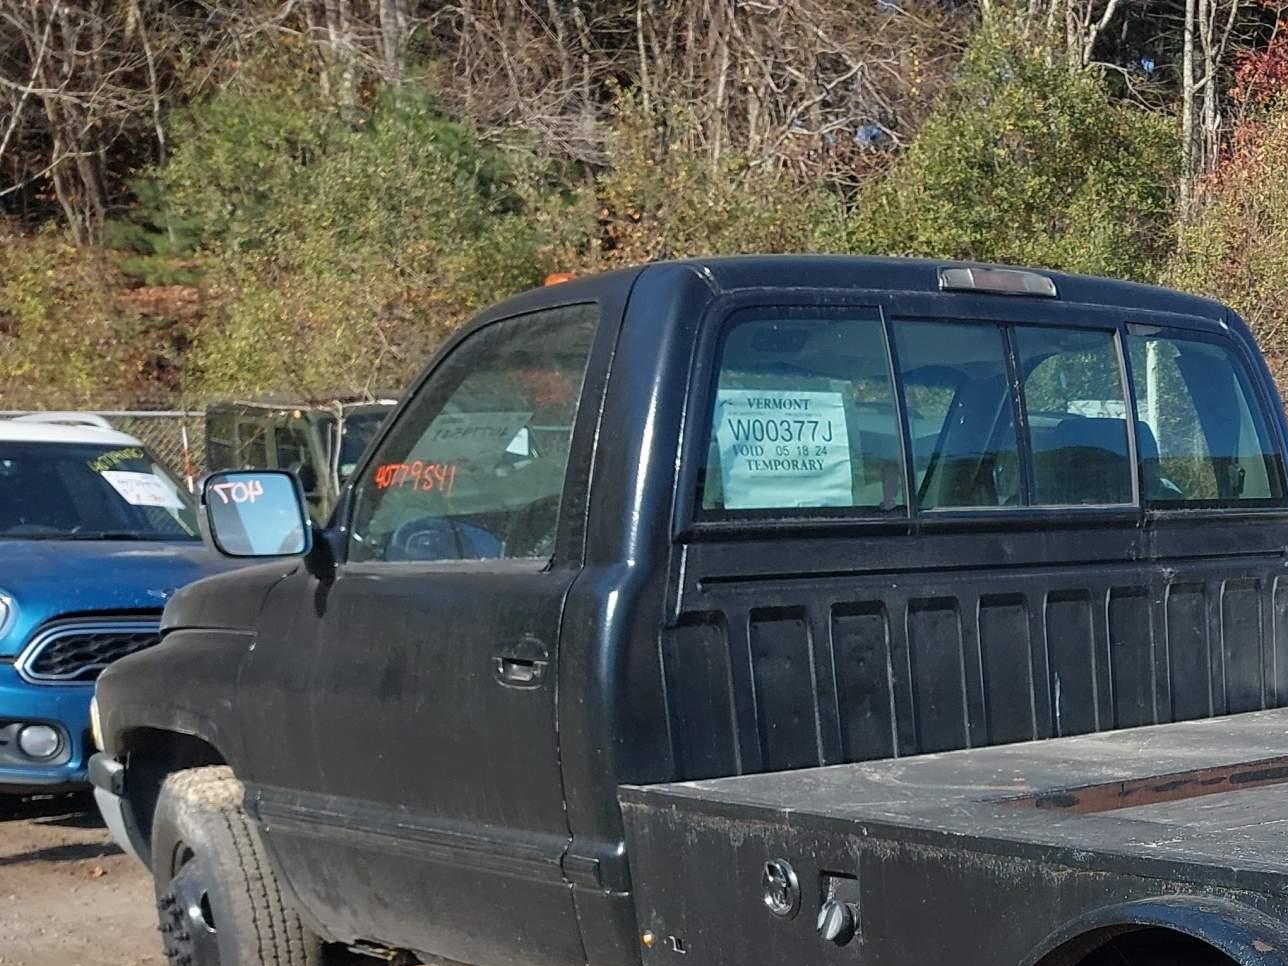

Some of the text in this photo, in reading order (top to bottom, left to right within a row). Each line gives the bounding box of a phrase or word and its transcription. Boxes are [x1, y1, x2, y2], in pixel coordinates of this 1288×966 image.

[747, 397, 811, 410] VERMONT
[727, 418, 833, 442] W00377J
[732, 444, 828, 457] VOID 05 18 24
[745, 459, 825, 471] TEMPORARY
[375, 459, 457, 496] 40779541
